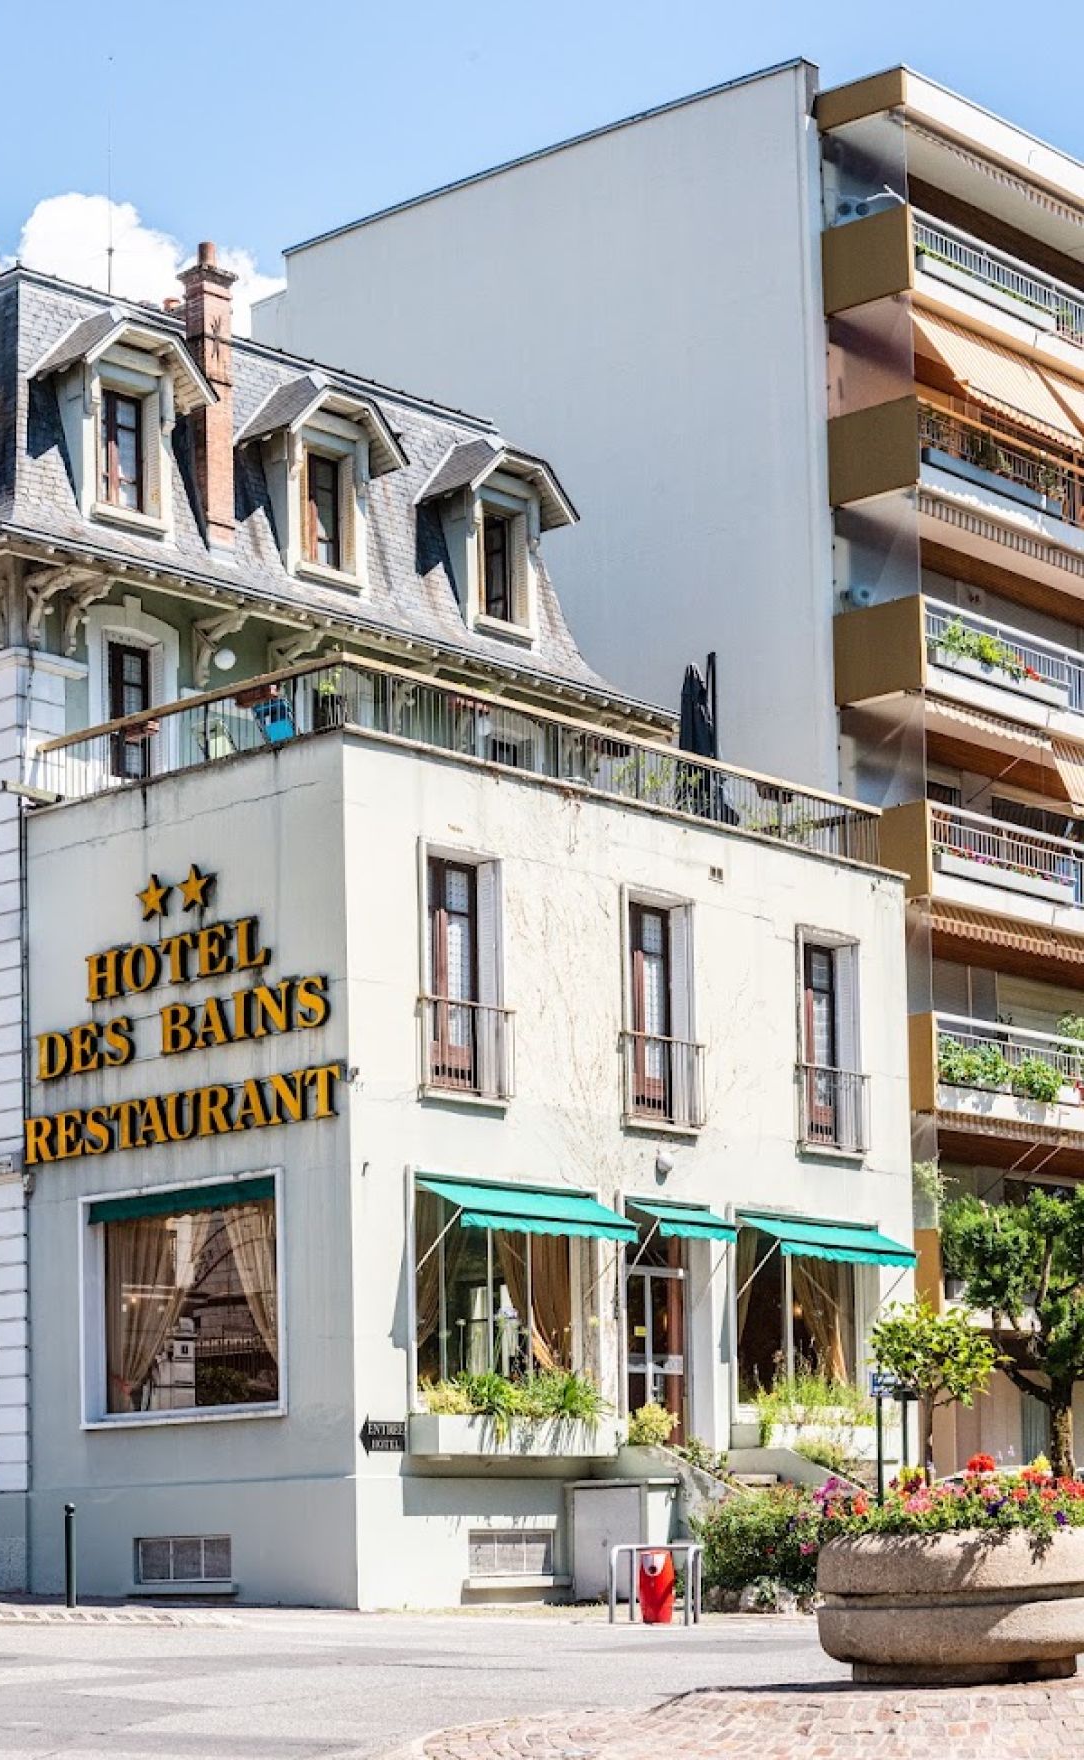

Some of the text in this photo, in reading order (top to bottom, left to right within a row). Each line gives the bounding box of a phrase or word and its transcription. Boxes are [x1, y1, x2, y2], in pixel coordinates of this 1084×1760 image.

[84, 916, 270, 1002] HOTEL
[36, 976, 330, 1081] DES BAINS
[23, 1063, 344, 1165] RESTAURANT
[371, 1439, 401, 1450] HOTEL
